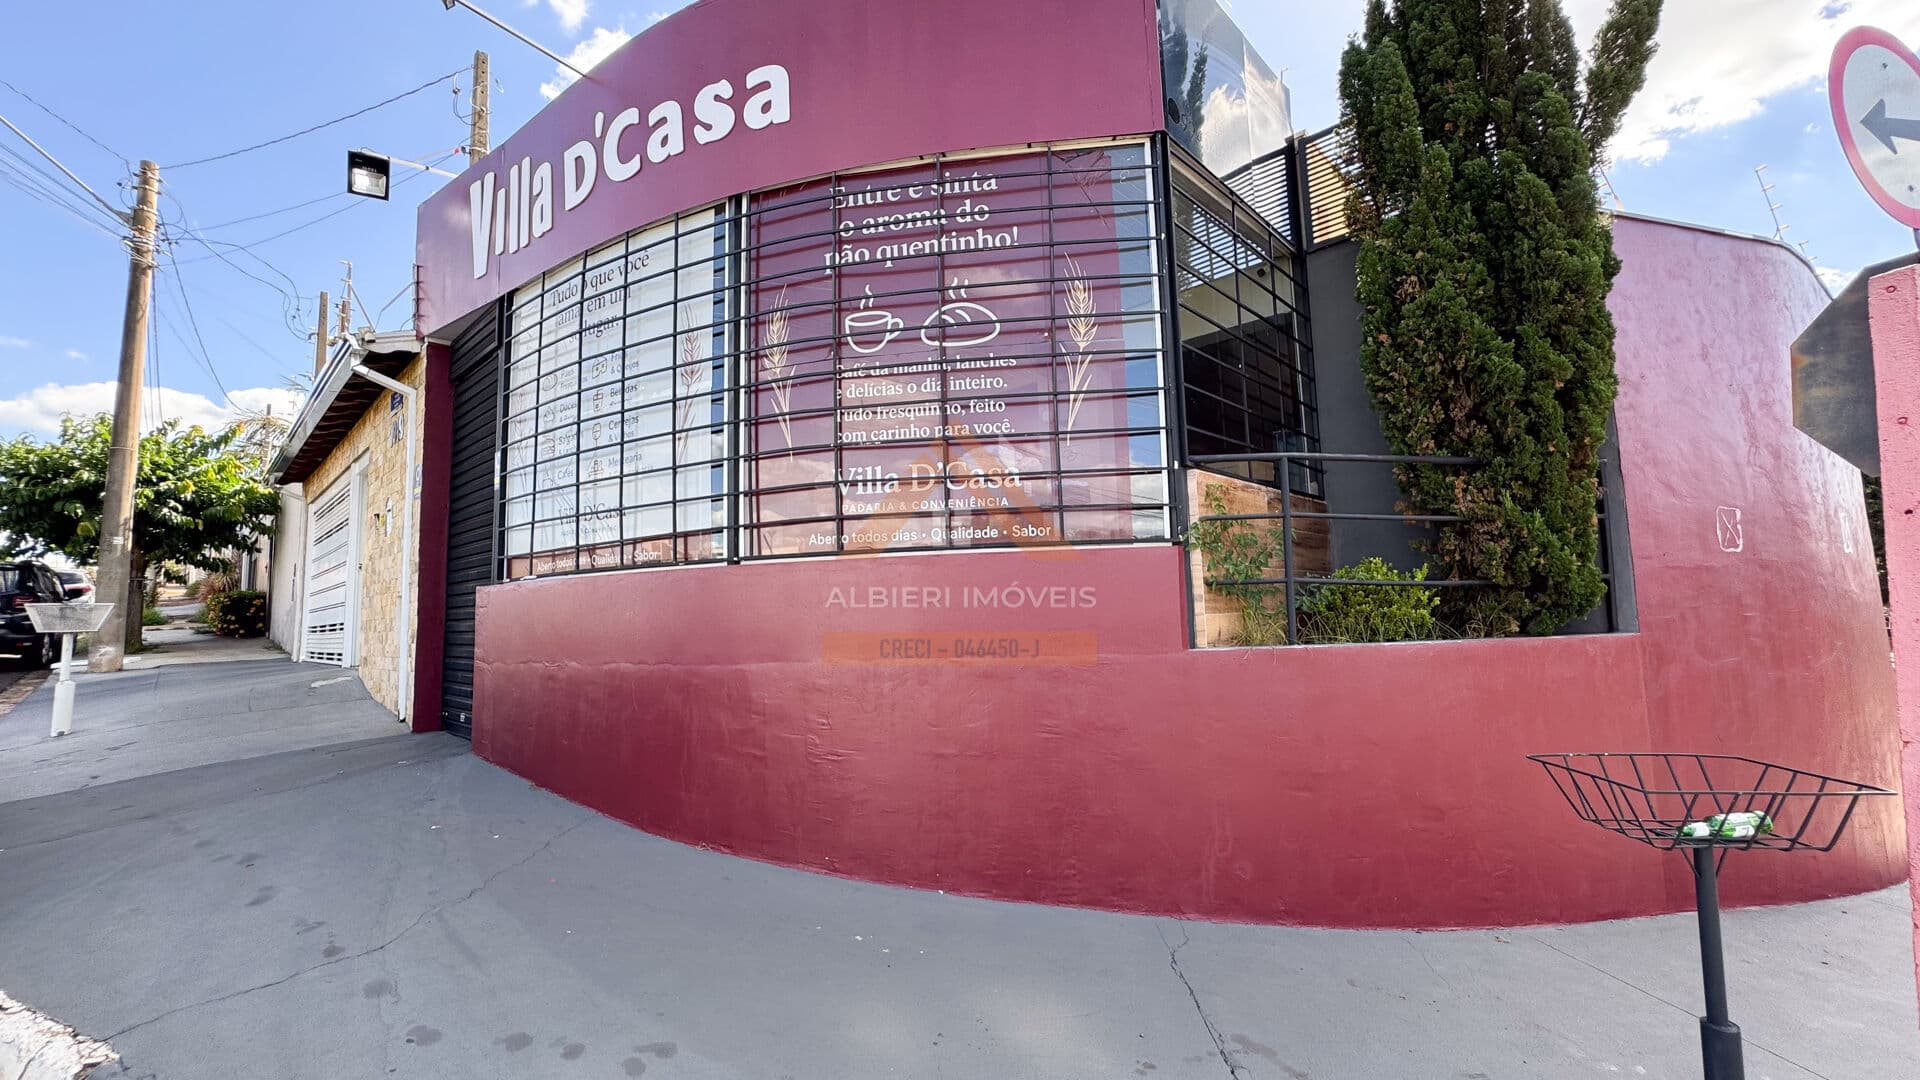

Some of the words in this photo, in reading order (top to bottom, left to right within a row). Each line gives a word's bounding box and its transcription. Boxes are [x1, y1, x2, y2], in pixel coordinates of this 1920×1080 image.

[469, 155, 554, 280] Villa
[563, 64, 792, 212] D'Casa
[829, 183, 901, 210] Entre
[908, 182, 924, 199] e
[931, 171, 999, 196] sinta
[839, 219, 855, 237] o
[862, 206, 948, 235] aroma
[956, 199, 991, 223] do
[824, 243, 870, 276] pão
[876, 225, 1020, 268] quentinho!
[550, 282, 579, 307] Tudo
[590, 267, 615, 292] que
[586, 295, 606, 313] em
[847, 381, 903, 399] delícias
[907, 382, 917, 394] o
[950, 374, 1008, 392] inteiro.
[970, 398, 1007, 414] feito
[608, 415, 640, 430] Cerejas
[871, 424, 930, 442] carinho
[973, 418, 1016, 435] você.
[831, 464, 901, 496] Villa
[842, 501, 894, 514] PADARIA
[898, 501, 907, 511] &
[911, 496, 1010, 510] CONVENIÊNCIA
[809, 532, 849, 546] Abero
[852, 530, 887, 544] todos
[891, 528, 918, 542] dias
[1012, 524, 1052, 538] Sabor
[633, 550, 658, 563] Sabor
